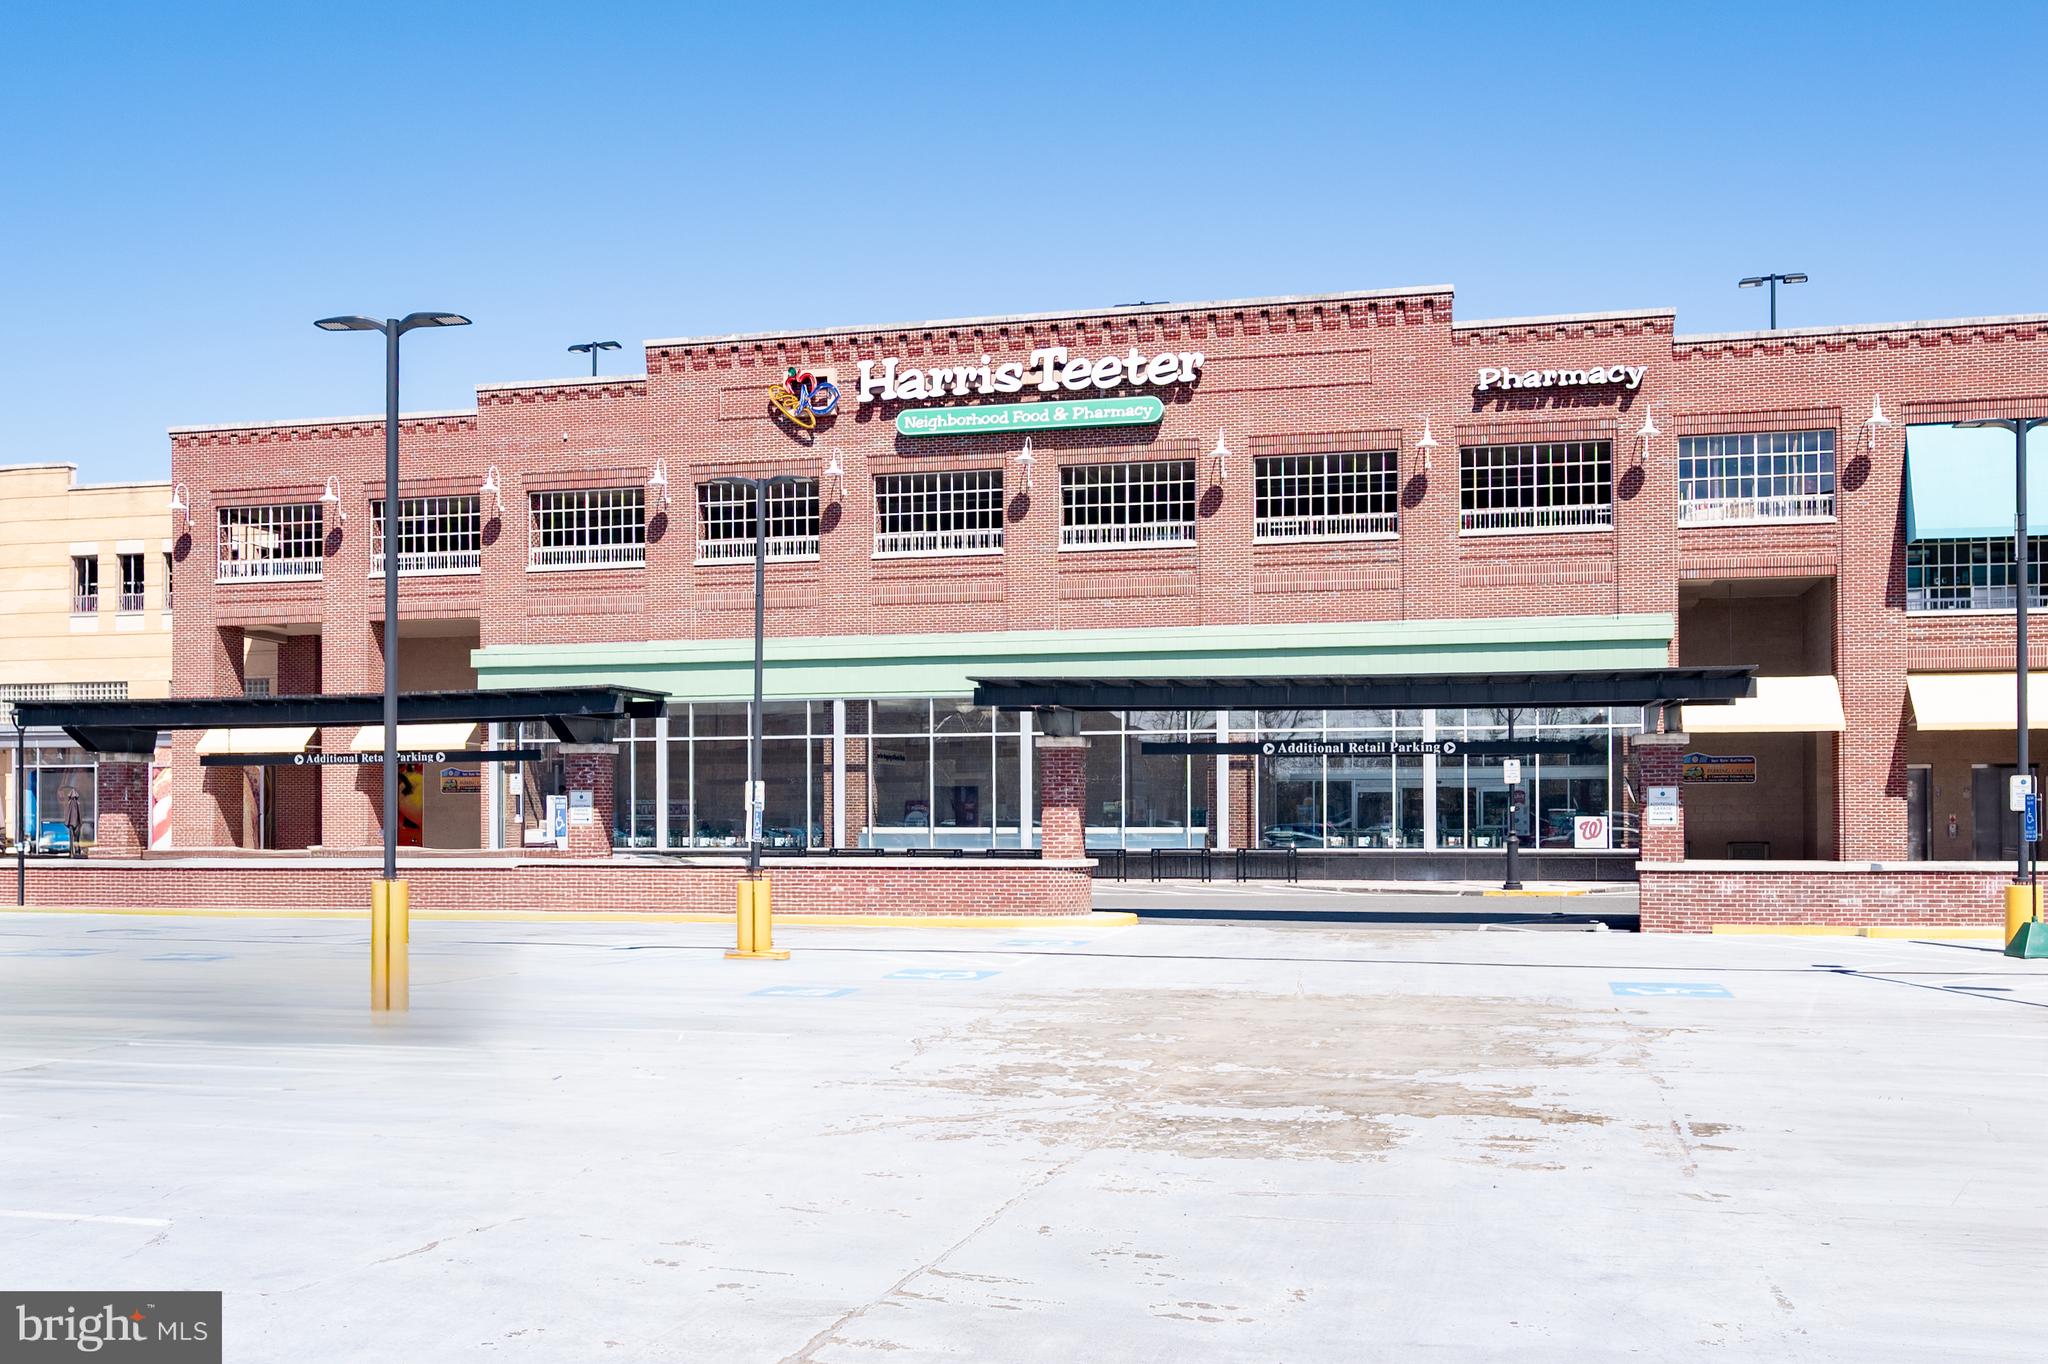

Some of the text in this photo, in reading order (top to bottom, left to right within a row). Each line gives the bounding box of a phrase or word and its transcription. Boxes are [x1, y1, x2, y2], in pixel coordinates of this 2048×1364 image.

[856, 346, 1205, 402] Harris Teeter
[1477, 364, 1648, 391] Pharmacy
[903, 404, 1153, 431] Neighborhood Food & Pharmacy
[306, 752, 358, 764] Additional
[1277, 742, 1440, 755] Additional Retail Parking
